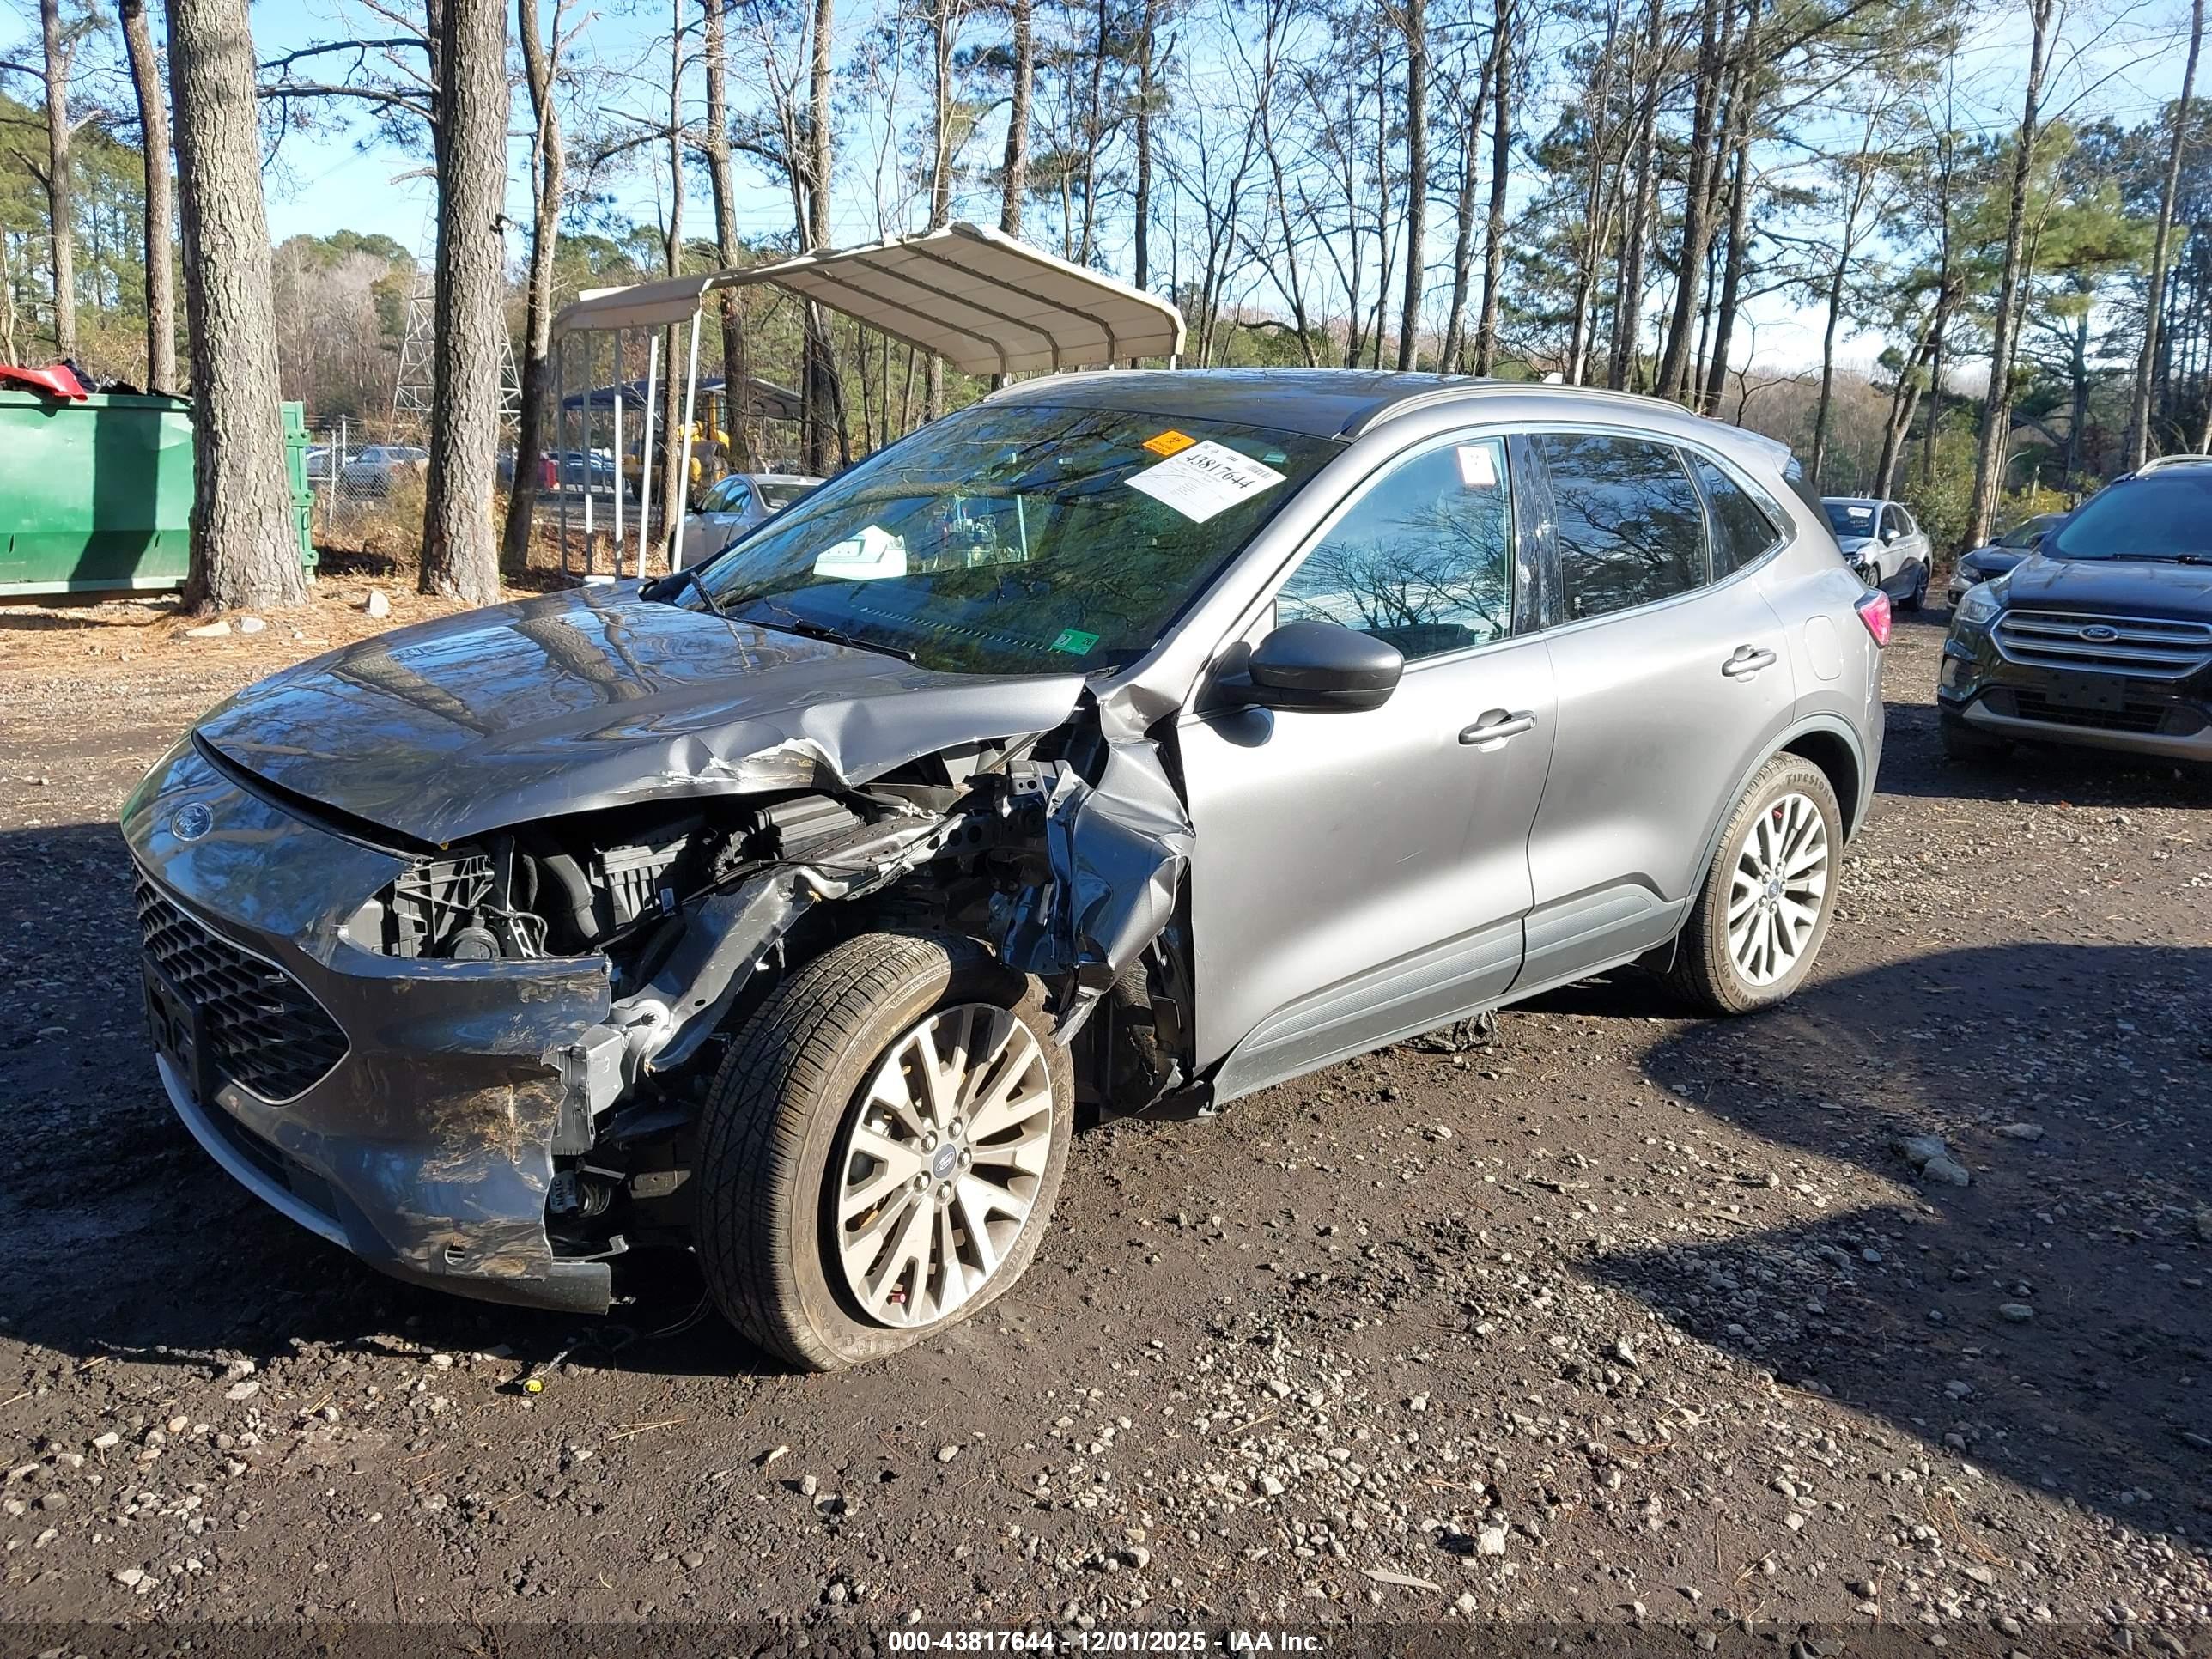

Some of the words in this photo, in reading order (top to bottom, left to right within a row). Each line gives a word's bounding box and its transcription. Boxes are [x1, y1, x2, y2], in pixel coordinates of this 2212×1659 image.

[1186, 454, 1255, 489] 43817644
[1061, 635, 1070, 644] 7
[1785, 772, 1833, 805] Firestone
